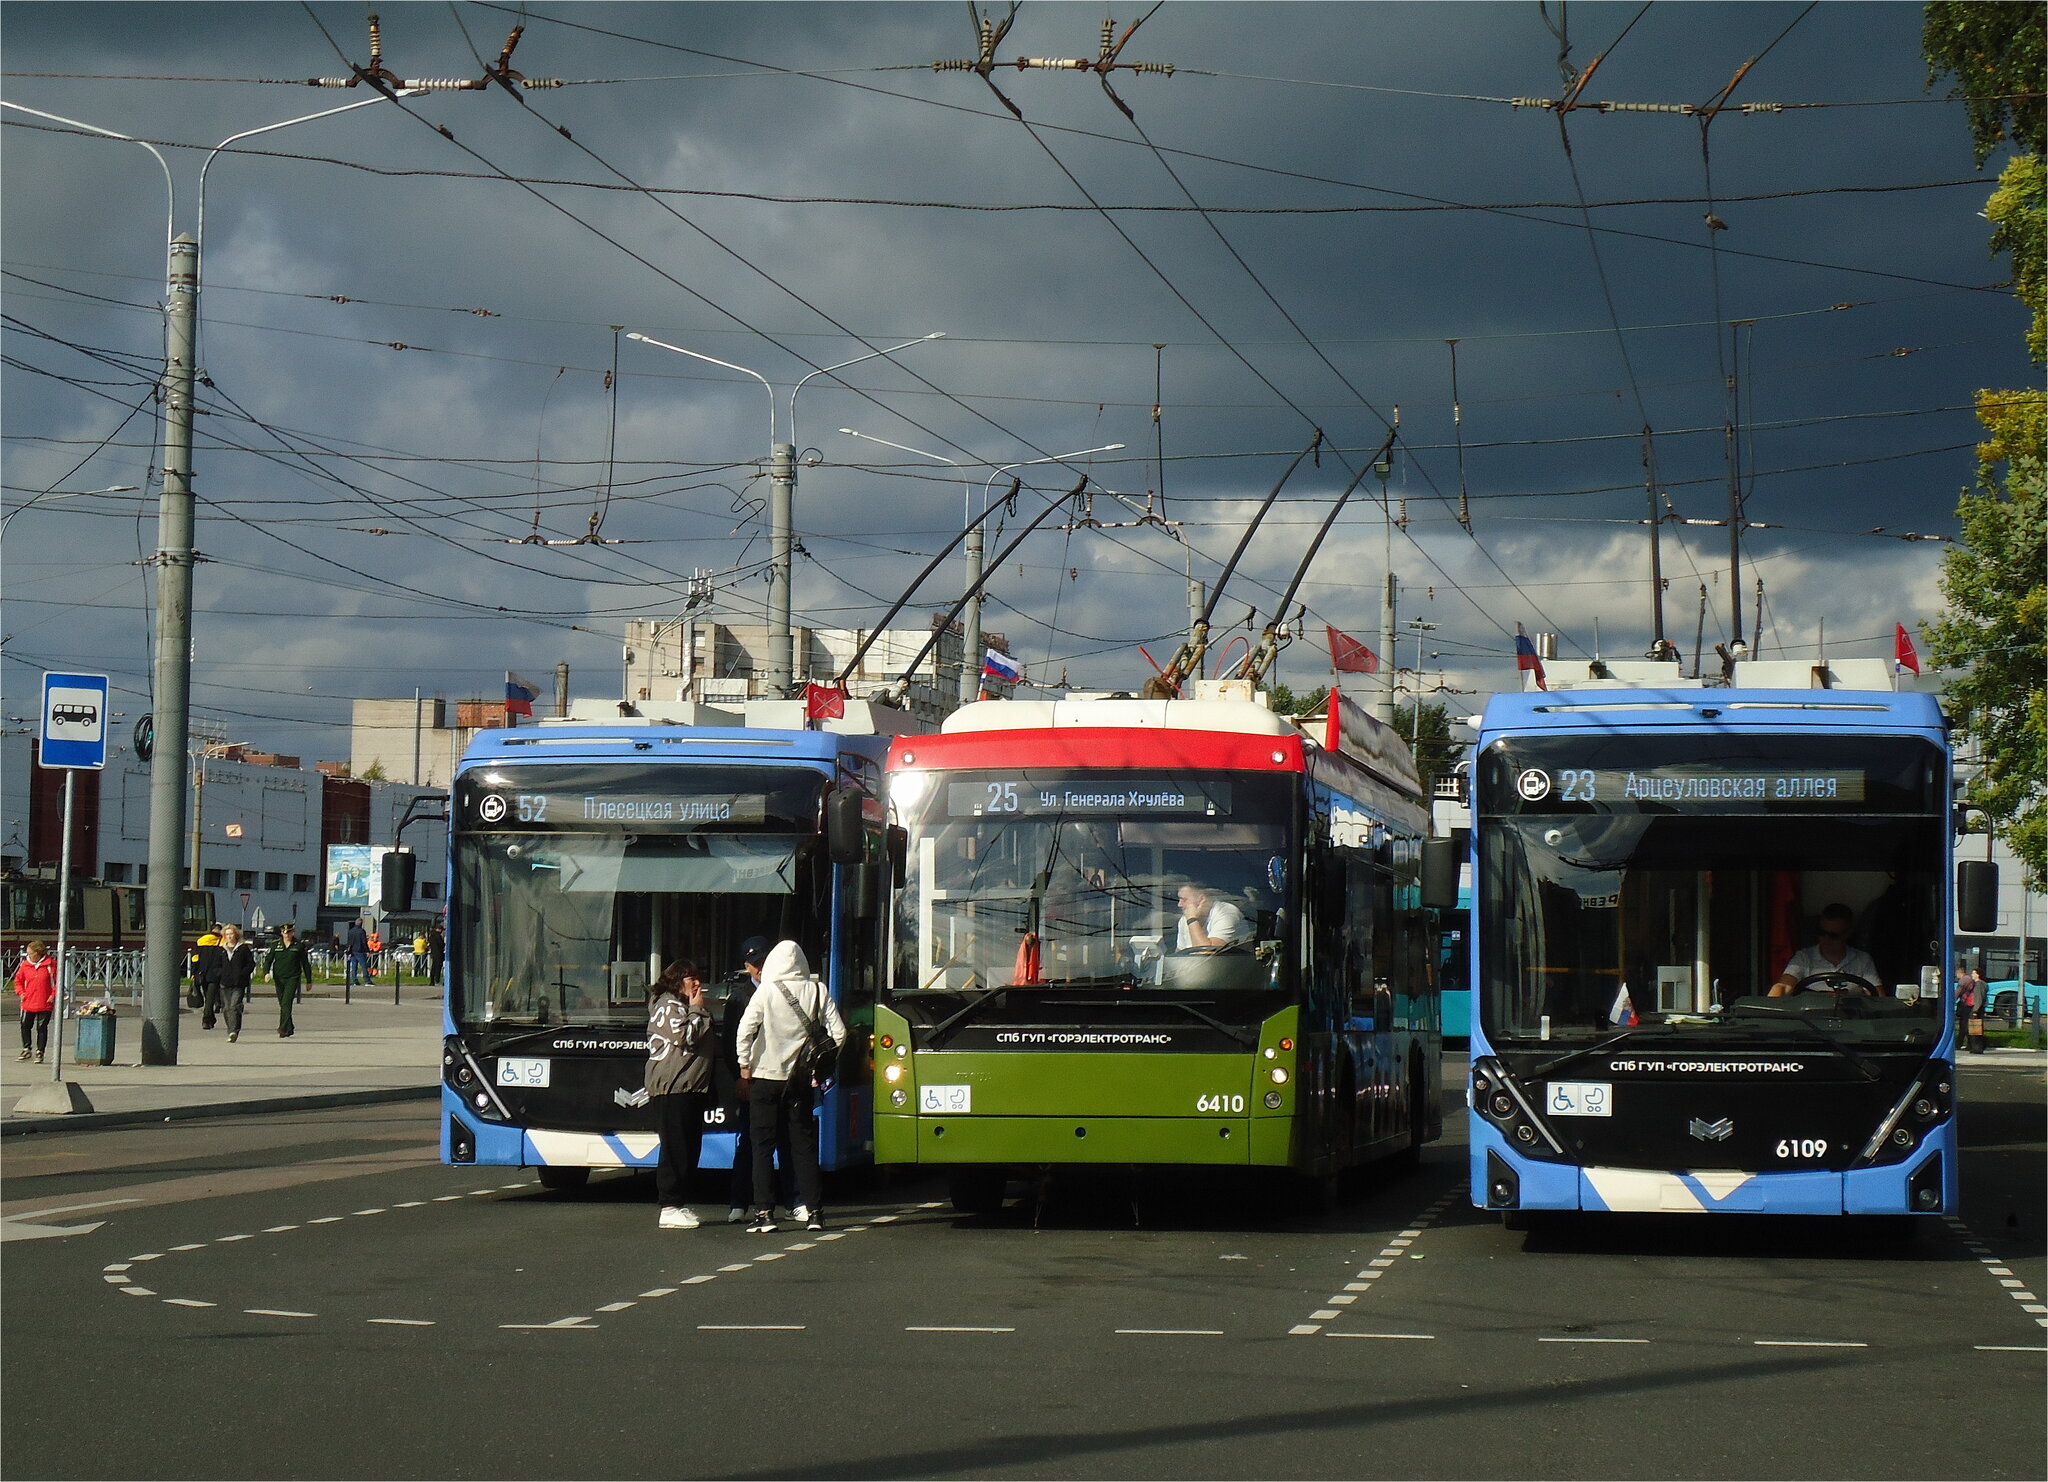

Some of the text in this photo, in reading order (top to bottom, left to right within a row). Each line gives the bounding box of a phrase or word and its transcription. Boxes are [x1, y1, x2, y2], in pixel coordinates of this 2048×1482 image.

[1561, 770, 1837, 801] 23 Арцеуловская аллея
[987, 782, 1185, 812] 25 Ул. Генерала Хрулёва
[519, 795, 731, 822] 52 Плесецкая улица
[553, 1040, 574, 1049] СПб
[576, 1040, 597, 1049] ГУП
[996, 1033, 1172, 1044] СПб ГУП «ГОРЭЛЕКТРОТРАНС»
[1610, 1061, 1804, 1073] СПб ГУП «ГОРЭЛЕКТРОТРАНС»
[1196, 1094, 1244, 1113] 6410
[1776, 1139, 1828, 1158] 6109
